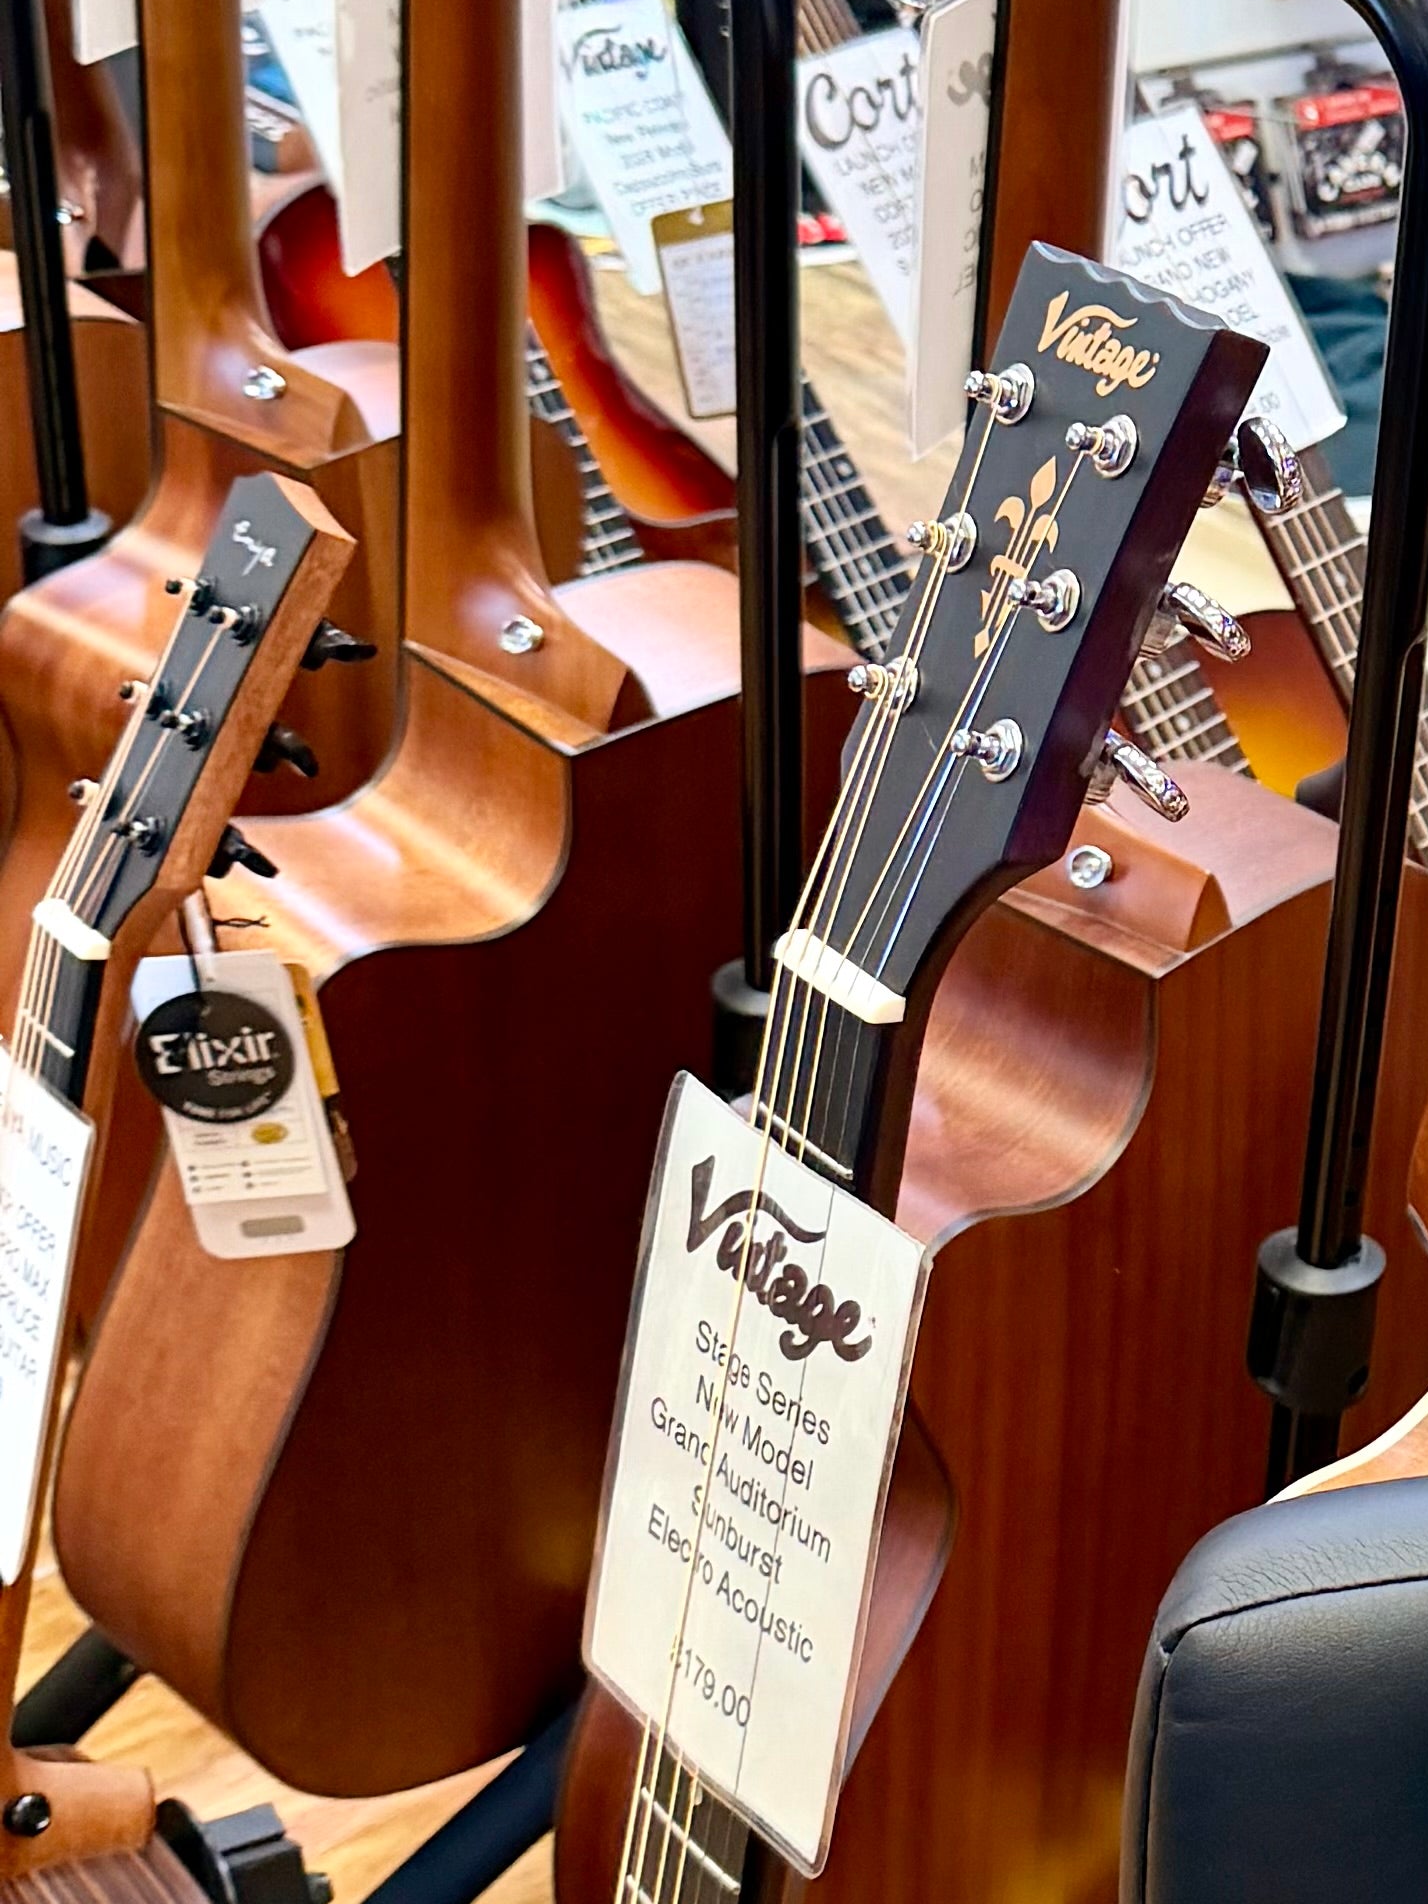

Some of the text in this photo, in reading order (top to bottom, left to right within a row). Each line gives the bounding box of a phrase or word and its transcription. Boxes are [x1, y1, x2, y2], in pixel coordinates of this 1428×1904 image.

[805, 62, 917, 150] Cort
[1123, 133, 1209, 224] ort
[1037, 290, 1157, 397] Vintage
[150, 1026, 275, 1075] Elixir
[686, 1155, 873, 1362] Vintage
[694, 1378, 815, 1493] New Model
[695, 1320, 833, 1446] Stage Series
[691, 1483, 783, 1586] Sunburst
[716, 1452, 833, 1565] Auditorium
[646, 1503, 815, 1664] Elecro Acoustic
